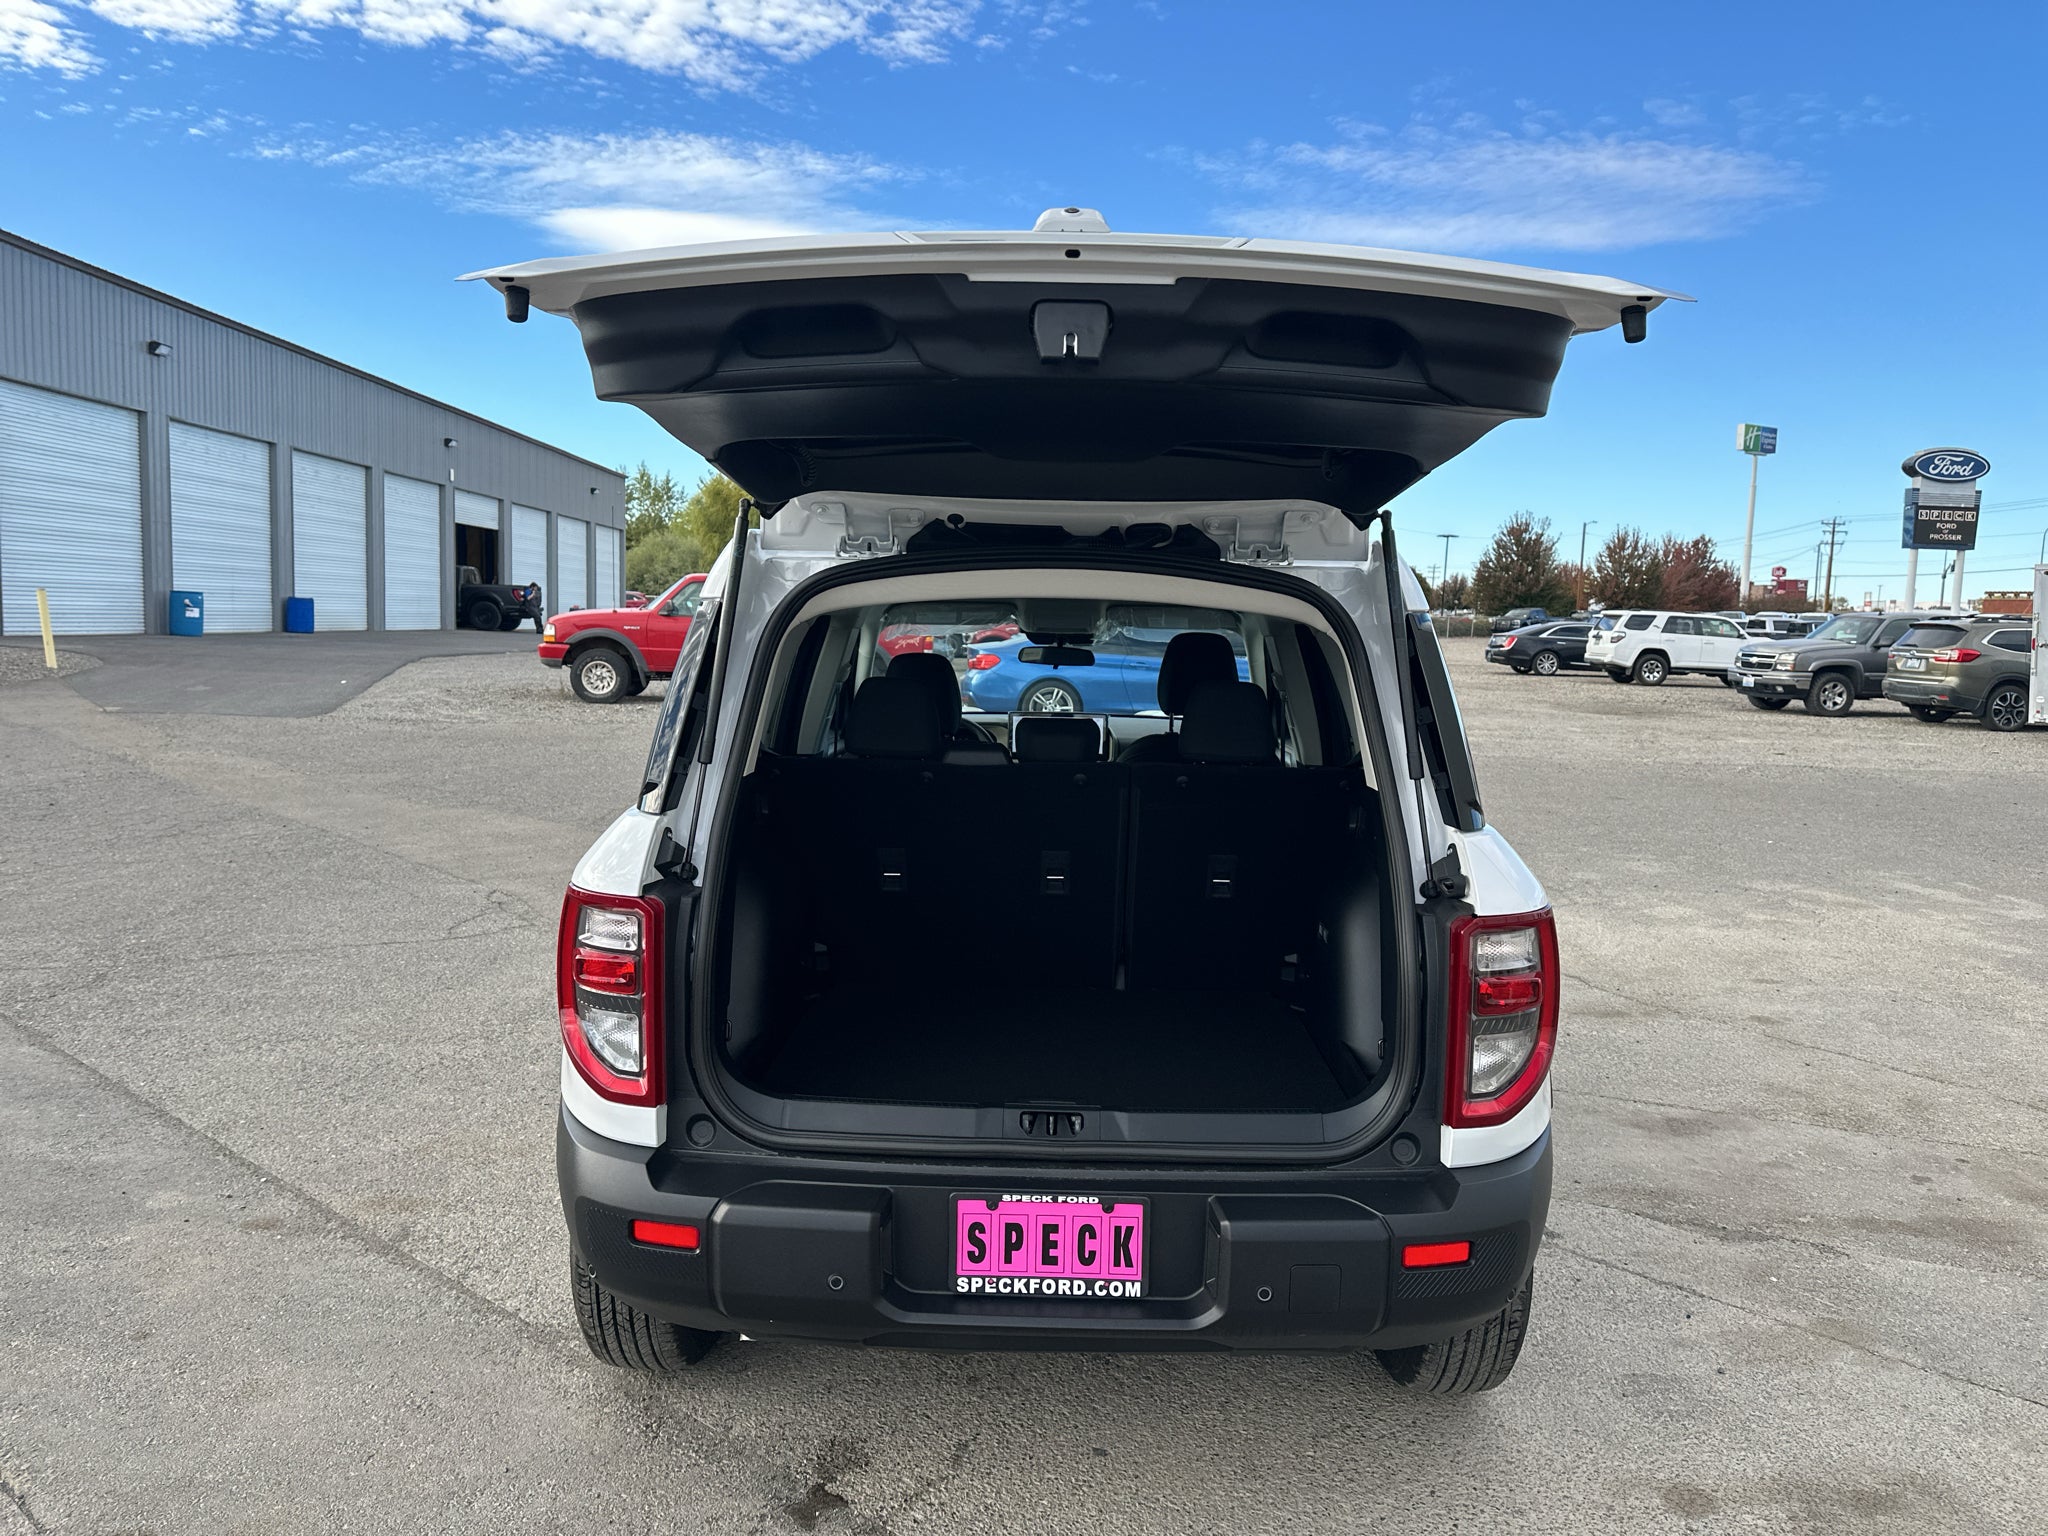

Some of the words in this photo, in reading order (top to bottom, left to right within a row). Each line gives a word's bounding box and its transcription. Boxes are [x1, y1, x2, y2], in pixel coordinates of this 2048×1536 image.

[1929, 455, 1975, 476] Ford
[1919, 510, 1976, 521] SPECK
[1929, 533, 1962, 541] PROSSER
[1002, 1194, 1053, 1203] SPECK
[1058, 1195, 1099, 1204] FORD
[967, 1221, 1134, 1268] SPECK
[956, 1277, 1141, 1297] SPECKFORD.COM
